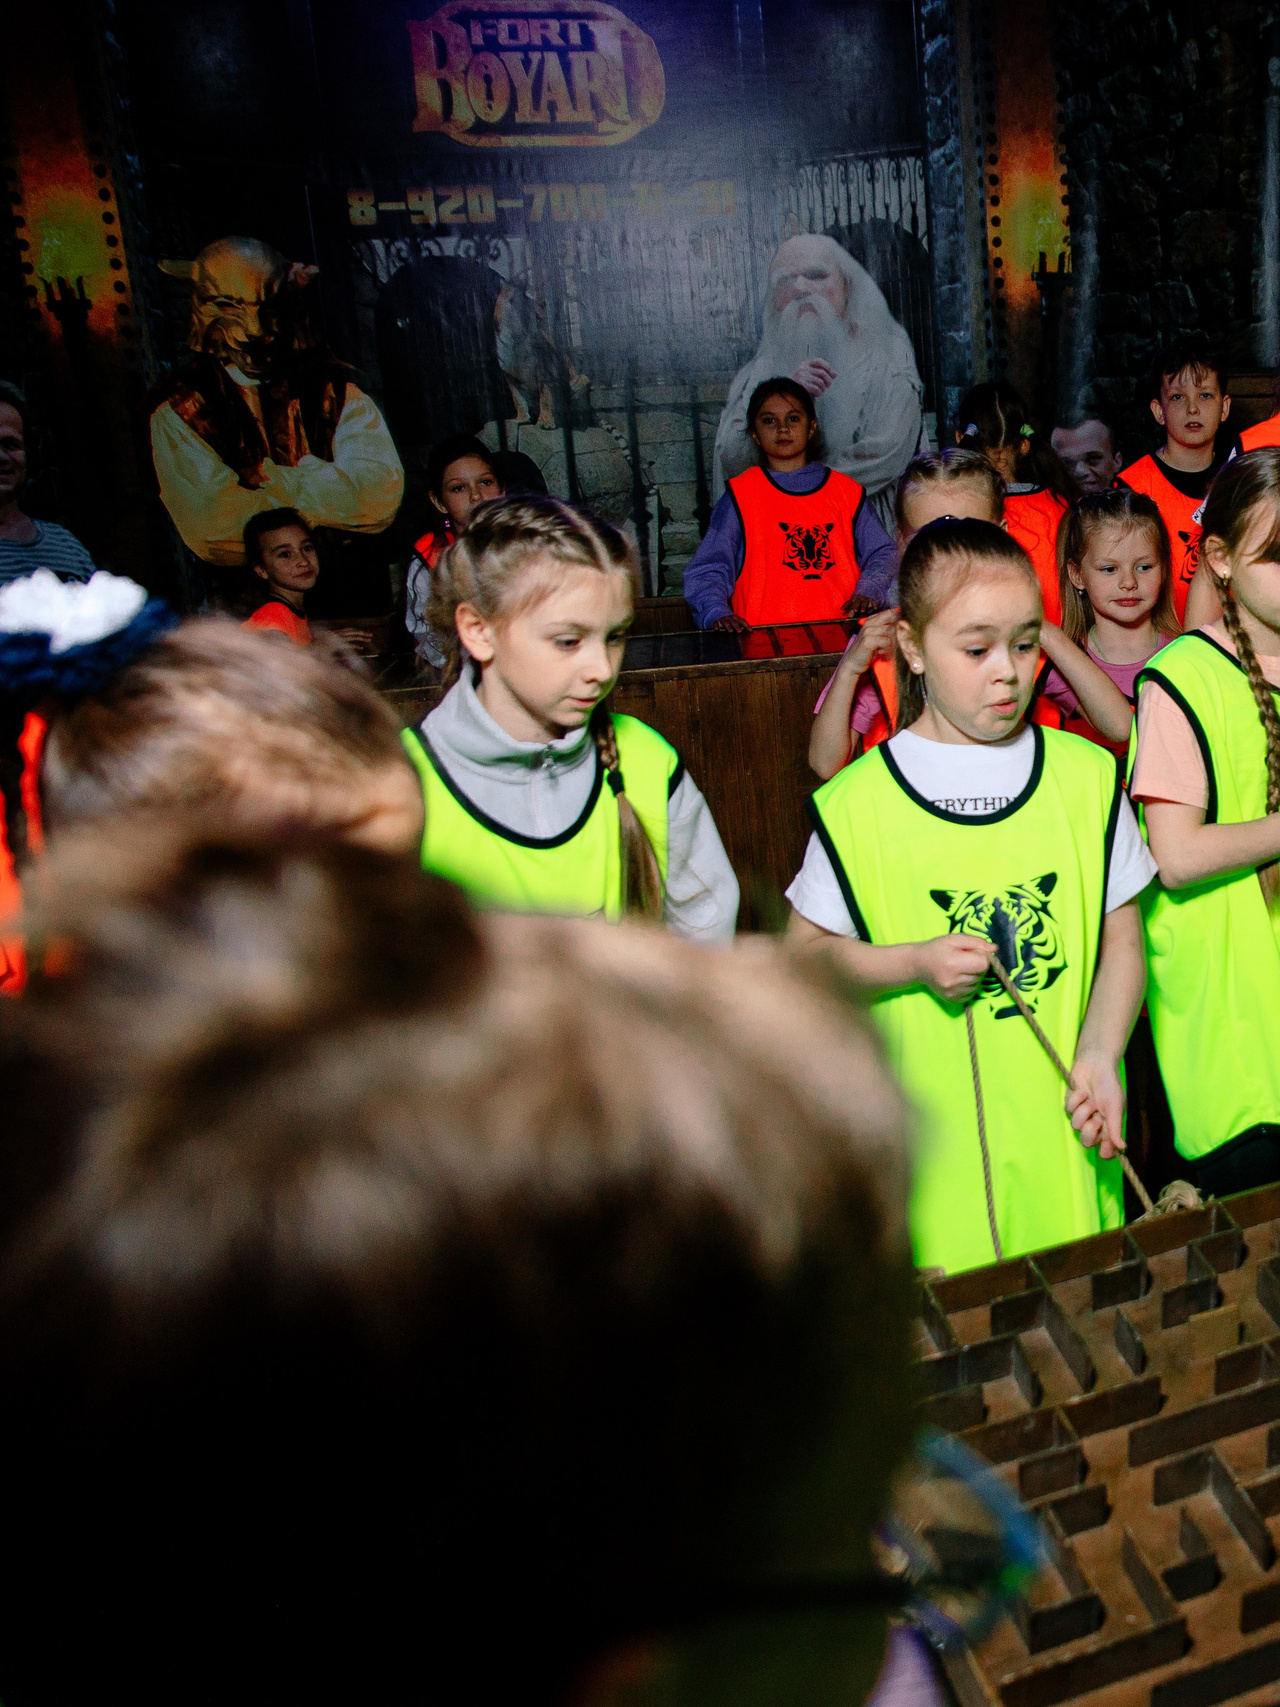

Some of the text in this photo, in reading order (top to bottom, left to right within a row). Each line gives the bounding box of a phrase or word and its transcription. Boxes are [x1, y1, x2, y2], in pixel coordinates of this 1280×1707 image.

[470, 19, 588, 47] FORT
[406, 19, 666, 134] BOYARD
[347, 181, 736, 226] 8-920-700-11-31
